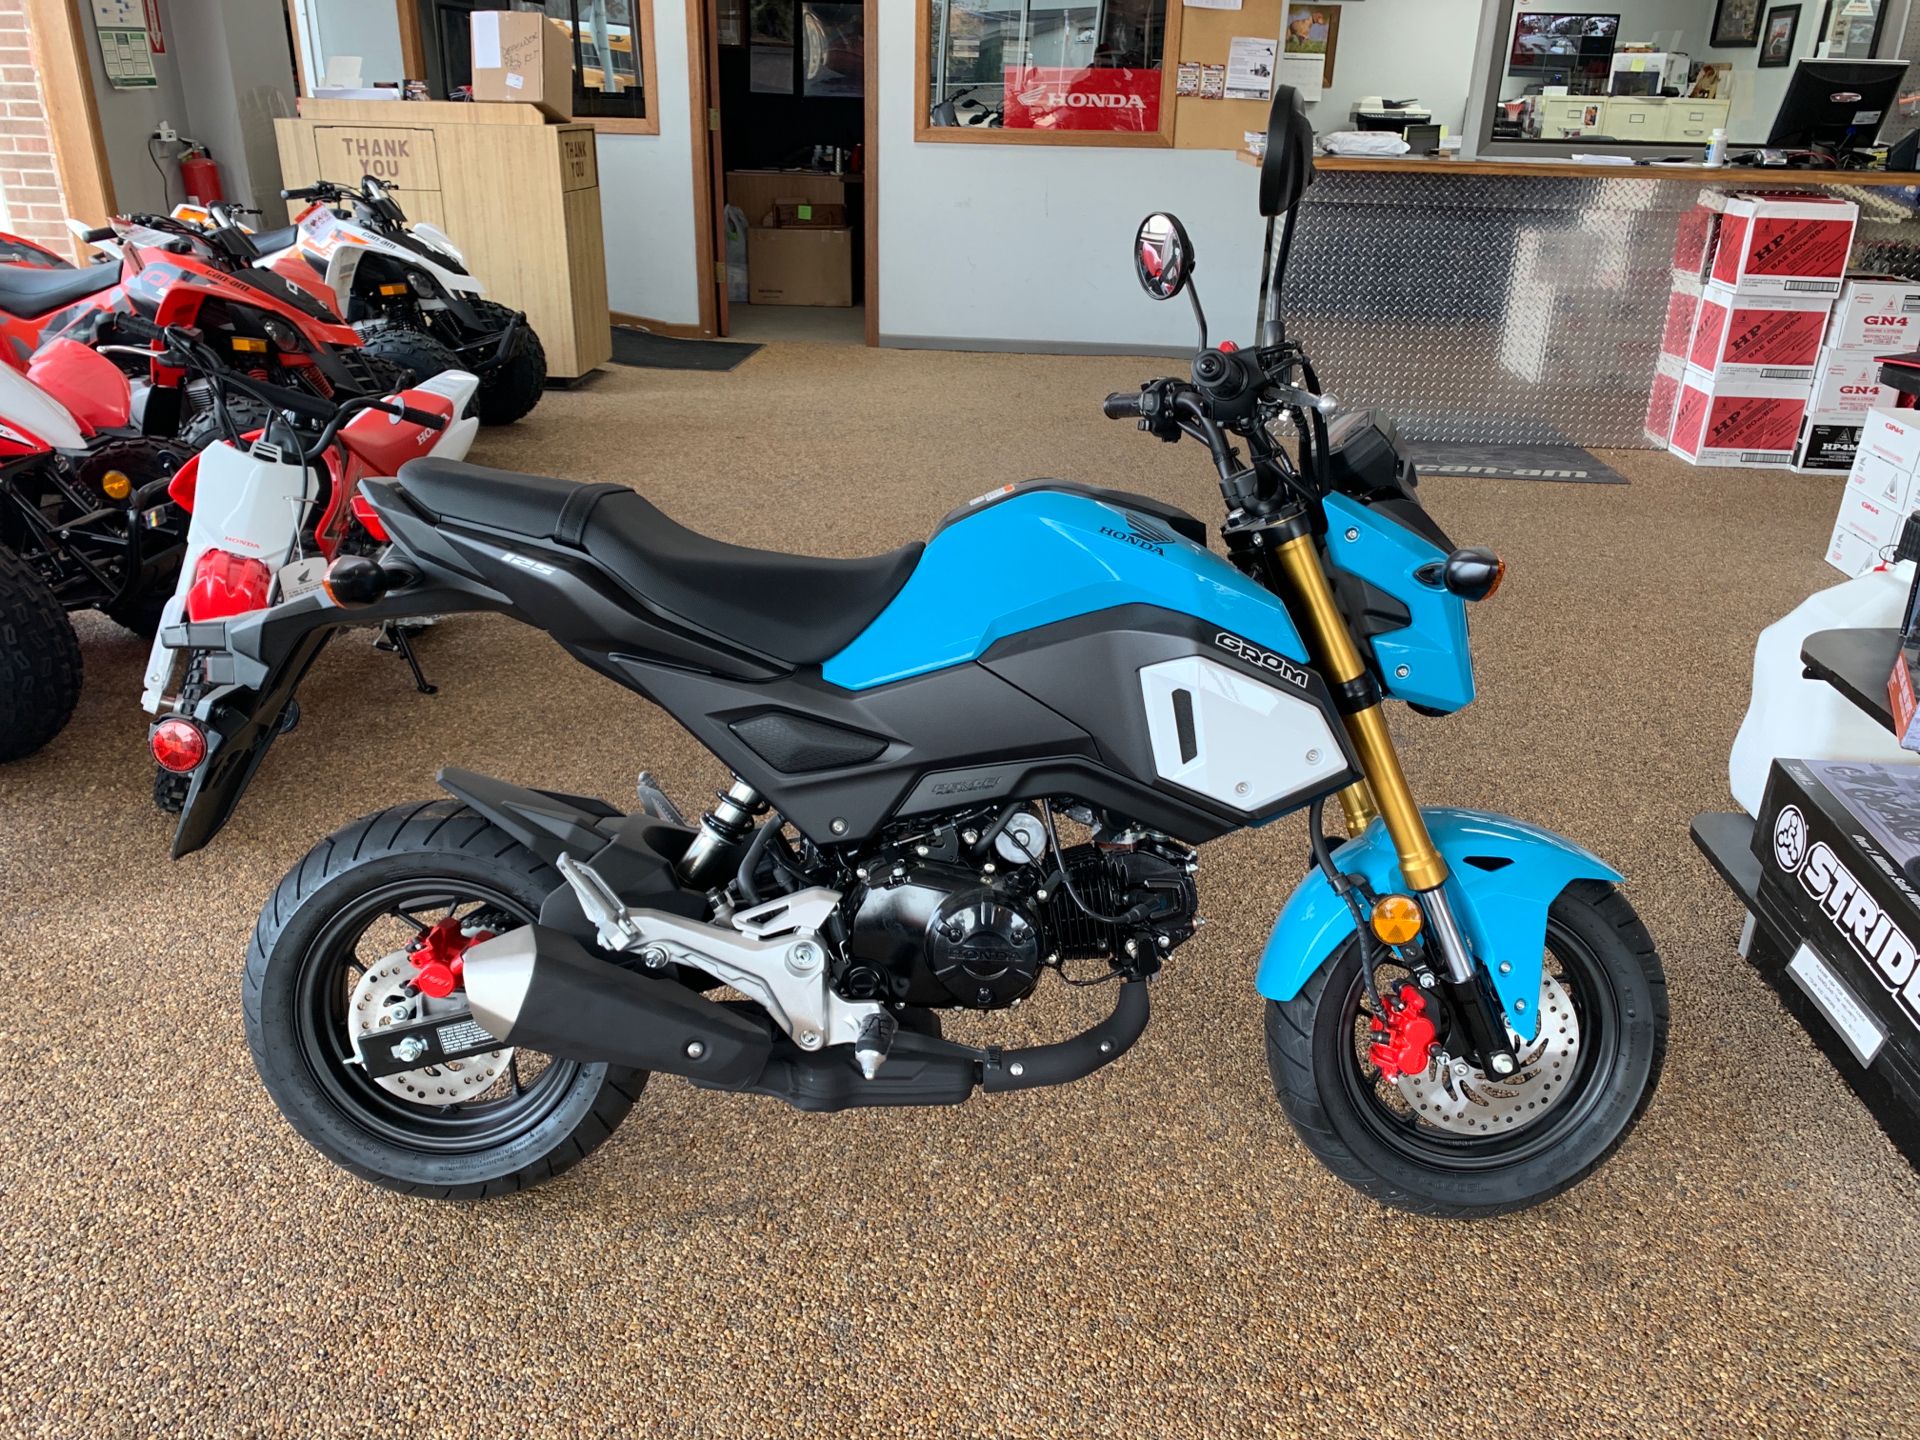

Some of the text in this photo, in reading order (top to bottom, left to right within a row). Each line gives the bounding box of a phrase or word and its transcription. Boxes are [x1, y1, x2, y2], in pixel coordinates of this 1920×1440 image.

[1047, 92, 1146, 109] HONDA
[341, 137, 410, 158] THANK
[565, 141, 587, 160] THANK
[360, 158, 400, 178] YOU
[570, 161, 585, 178] YOU
[361, 231, 398, 250] can-am
[1753, 233, 1787, 263] HP
[204, 268, 251, 293] can-am
[1863, 315, 1909, 327] GN4
[1731, 323, 1763, 351] HP
[1839, 385, 1880, 395] GN4
[1711, 409, 1743, 437] HP
[1884, 421, 1904, 436] GN4
[1415, 463, 1588, 478] can-am
[1861, 500, 1880, 515] GN4
[224, 535, 261, 549] HONDA
[1099, 526, 1164, 557] HONDA
[501, 552, 557, 575] 125
[1214, 631, 1309, 689] GROM
[947, 948, 1025, 962] HONDA
